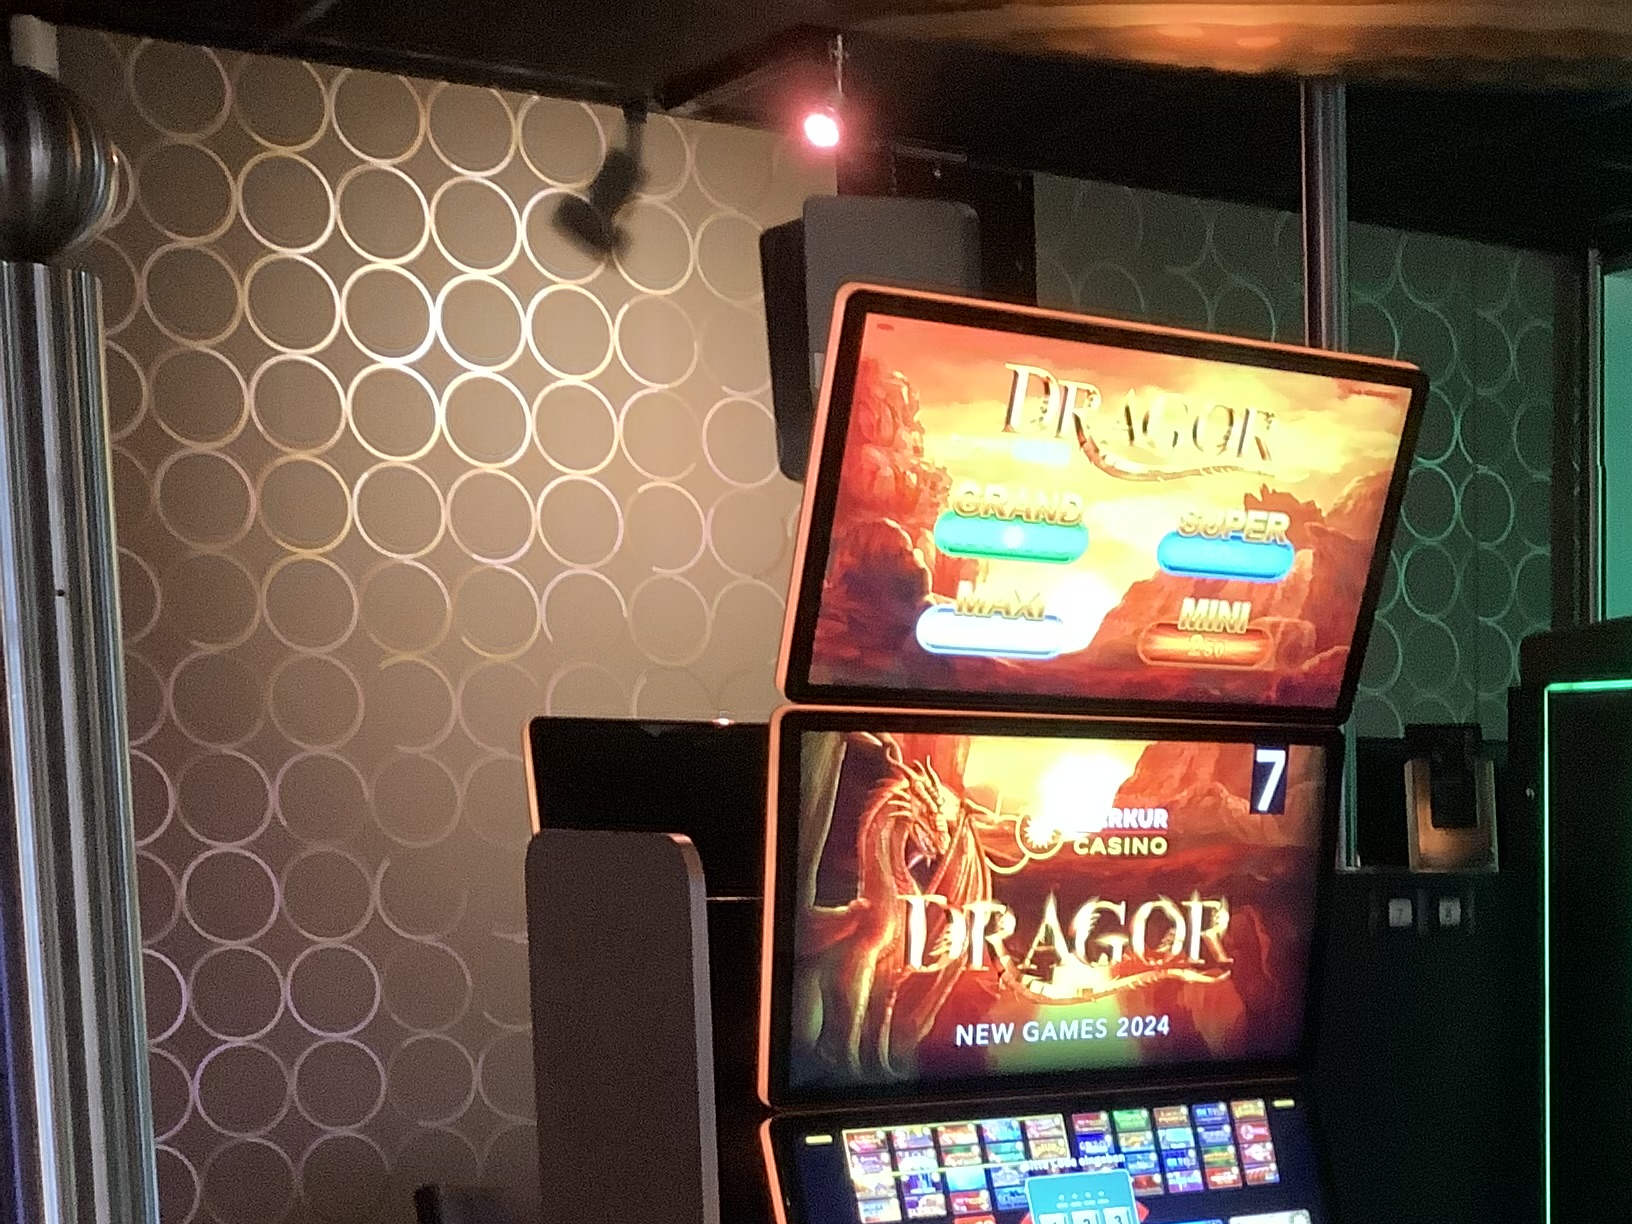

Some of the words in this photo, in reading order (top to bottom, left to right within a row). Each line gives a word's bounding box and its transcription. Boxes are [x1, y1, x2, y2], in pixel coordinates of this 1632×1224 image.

[1002, 362, 1278, 474] DRAGOR
[953, 481, 1083, 526] GRAND
[1178, 510, 1290, 544] SUPER
[954, 580, 1046, 621] MAXI
[1178, 598, 1251, 633] MINI
[1256, 749, 1286, 811] 7
[1082, 808, 1168, 829] RKUR
[1073, 836, 1168, 855] CASINO
[897, 892, 1234, 990] DRAGOR
[956, 1023, 1015, 1047] NEW
[1023, 1018, 1108, 1042] GAMES
[1116, 1015, 1170, 1037] 2024
